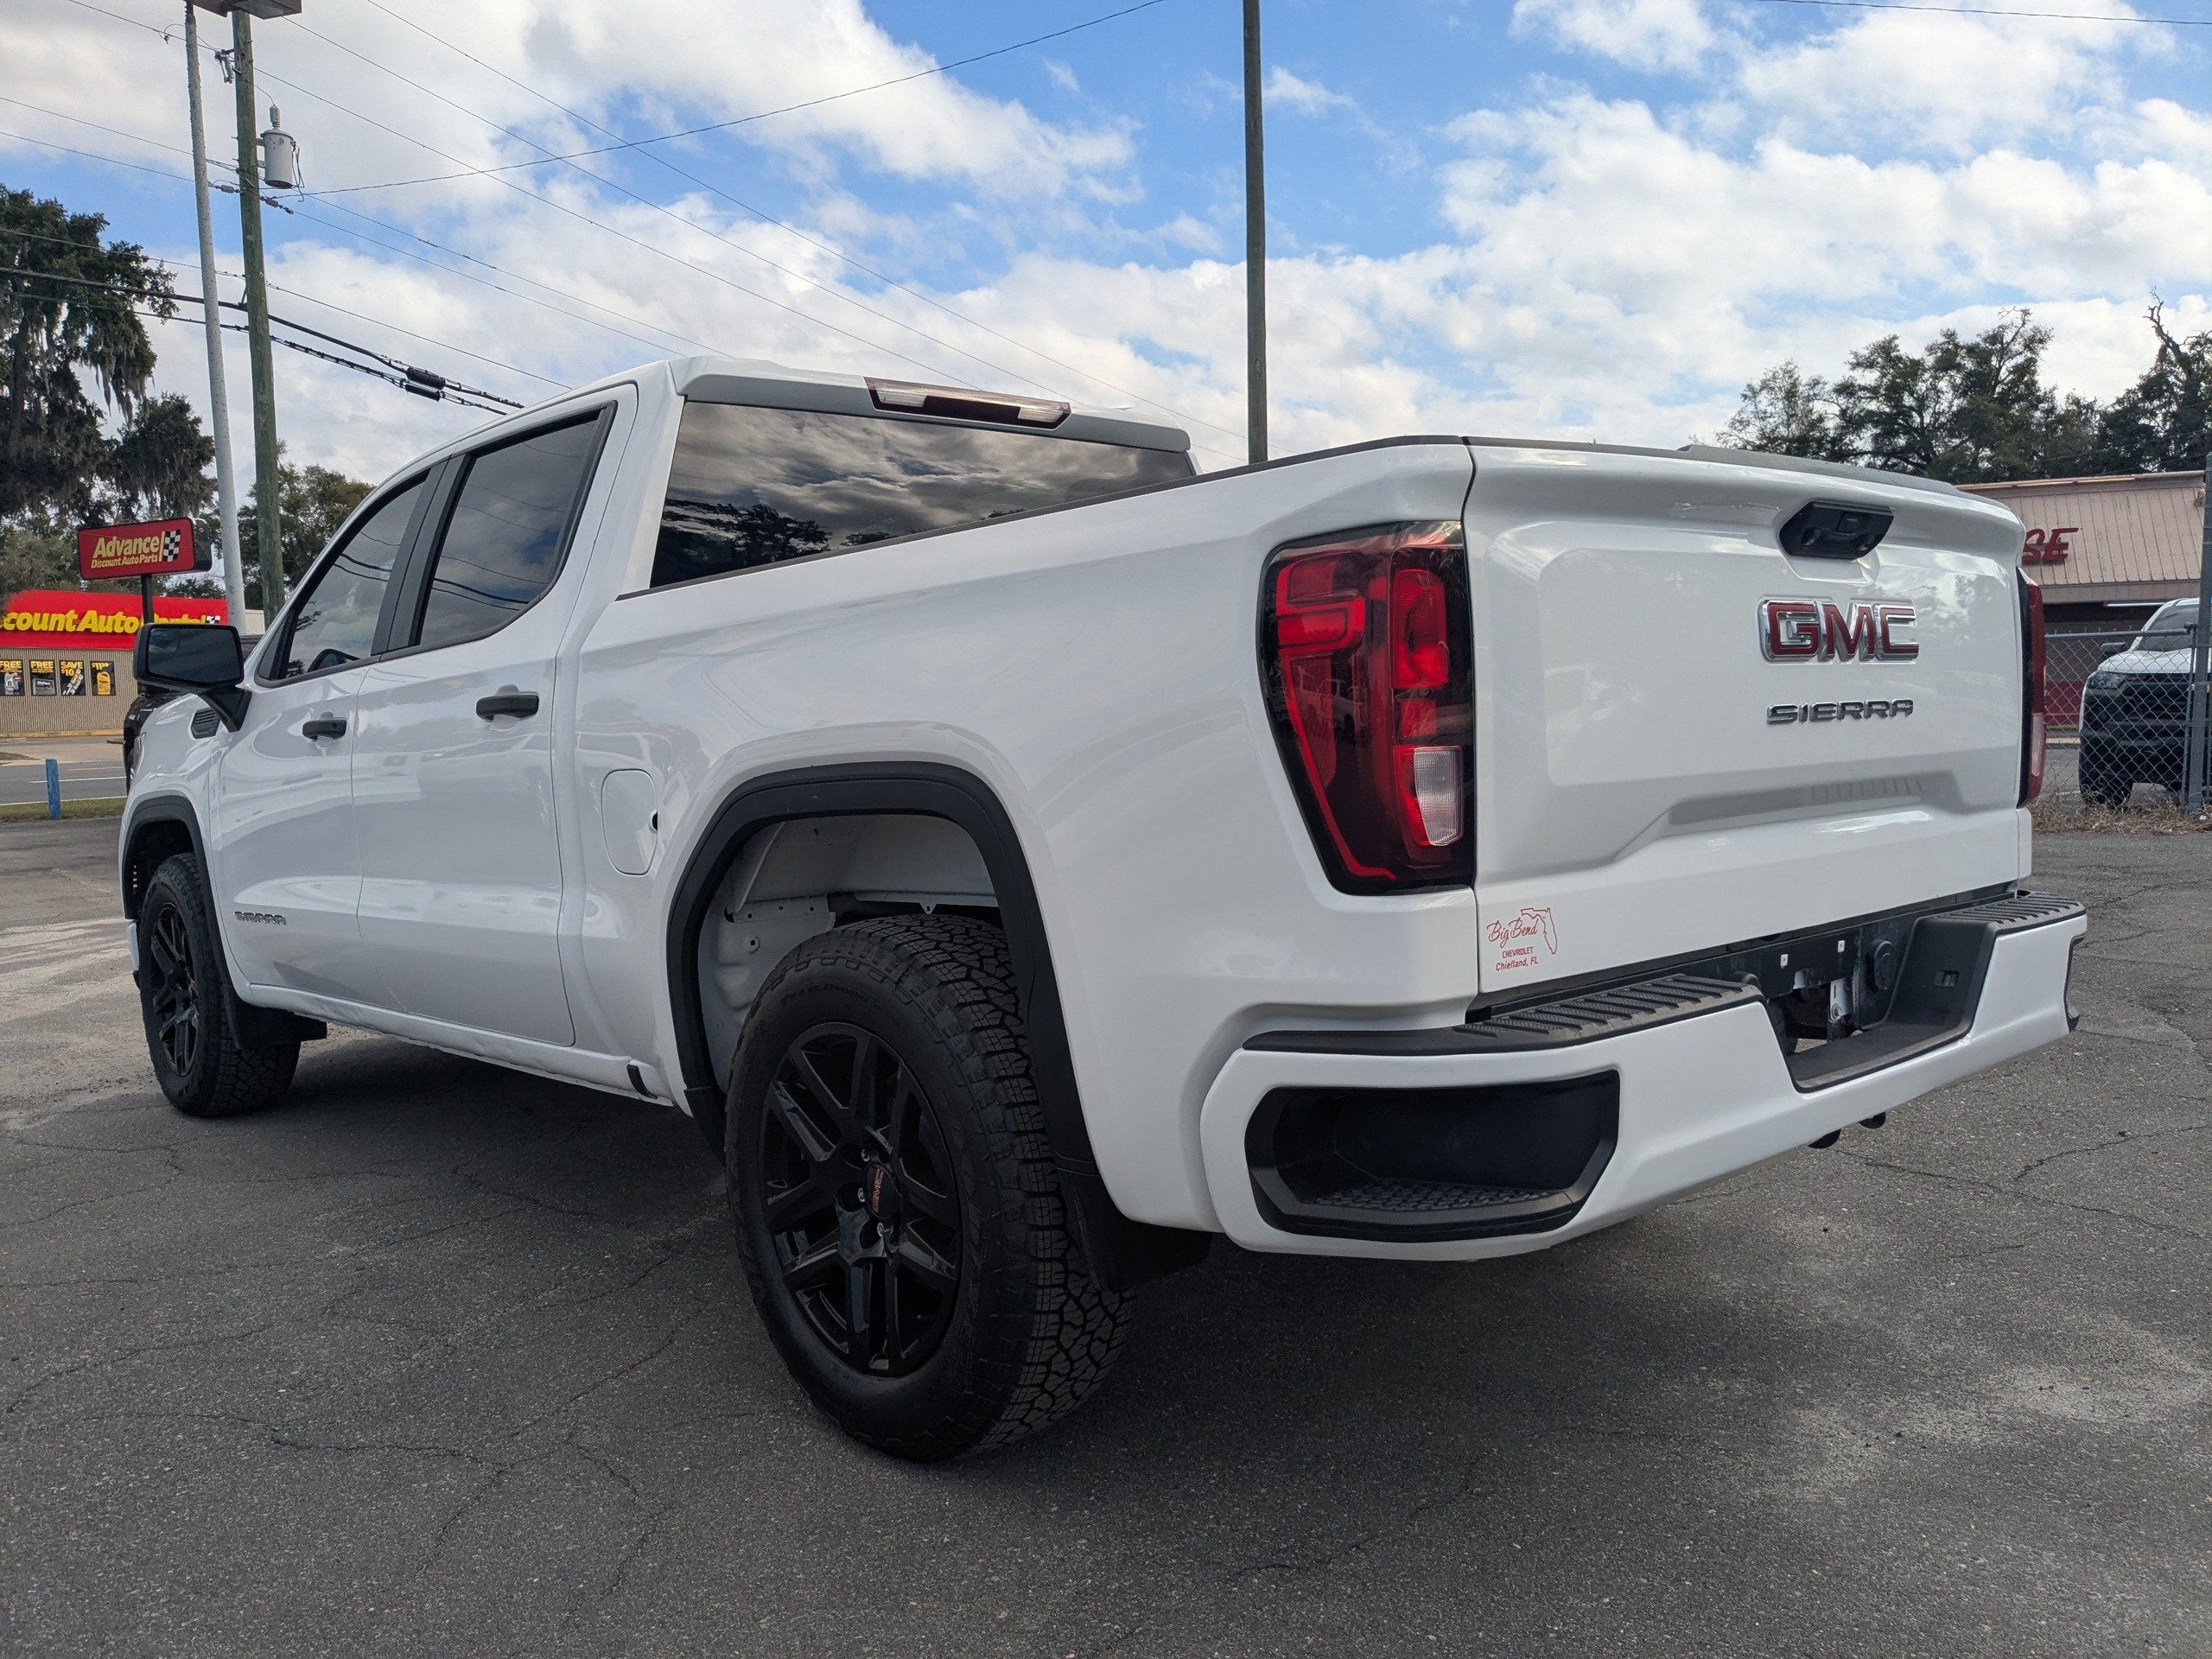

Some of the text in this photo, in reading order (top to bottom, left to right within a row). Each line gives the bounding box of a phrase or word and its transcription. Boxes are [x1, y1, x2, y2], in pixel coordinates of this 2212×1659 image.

[92, 536, 160, 558] Advance
[91, 554, 158, 569] Discount Auto Parts
[0, 609, 79, 632] count
[78, 610, 139, 633] Auto
[1758, 600, 1919, 662] GMC
[30, 660, 54, 669] FREE
[60, 661, 84, 670] SAVE
[1766, 699, 1914, 725] SIERRA
[1486, 917, 1539, 948] Big Bend
[1502, 946, 1534, 958] CHEVROLET
[1496, 957, 1538, 971] Chiefland, FL
